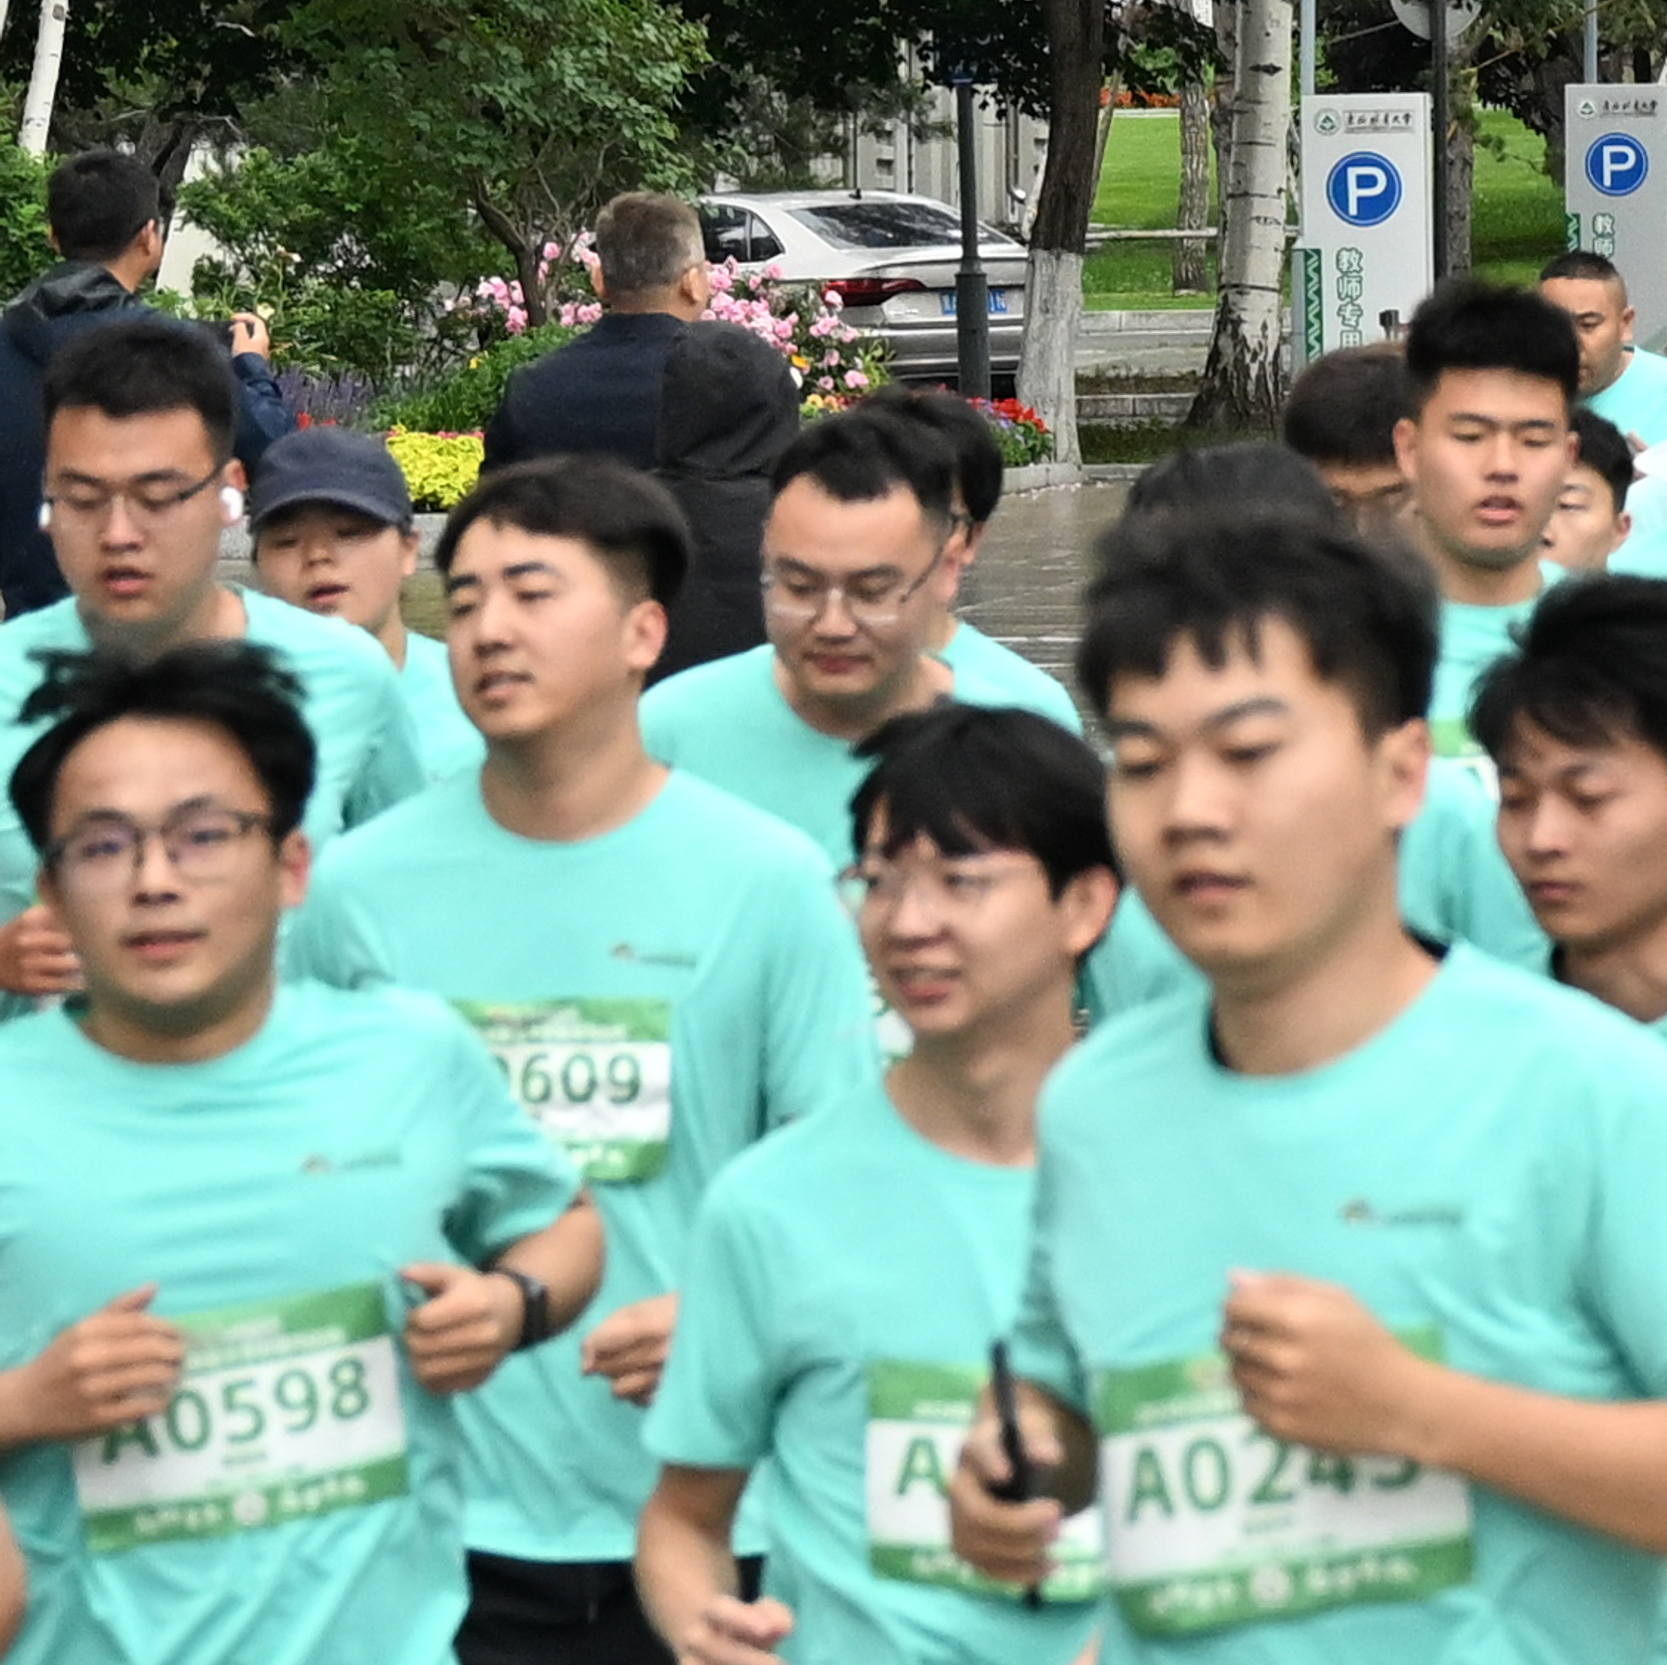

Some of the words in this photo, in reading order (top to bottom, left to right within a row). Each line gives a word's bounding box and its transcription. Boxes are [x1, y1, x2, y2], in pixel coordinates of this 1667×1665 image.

[1346, 166, 1387, 216] P
[1603, 145, 1636, 188] P
[497, 1052, 641, 1104] 609
